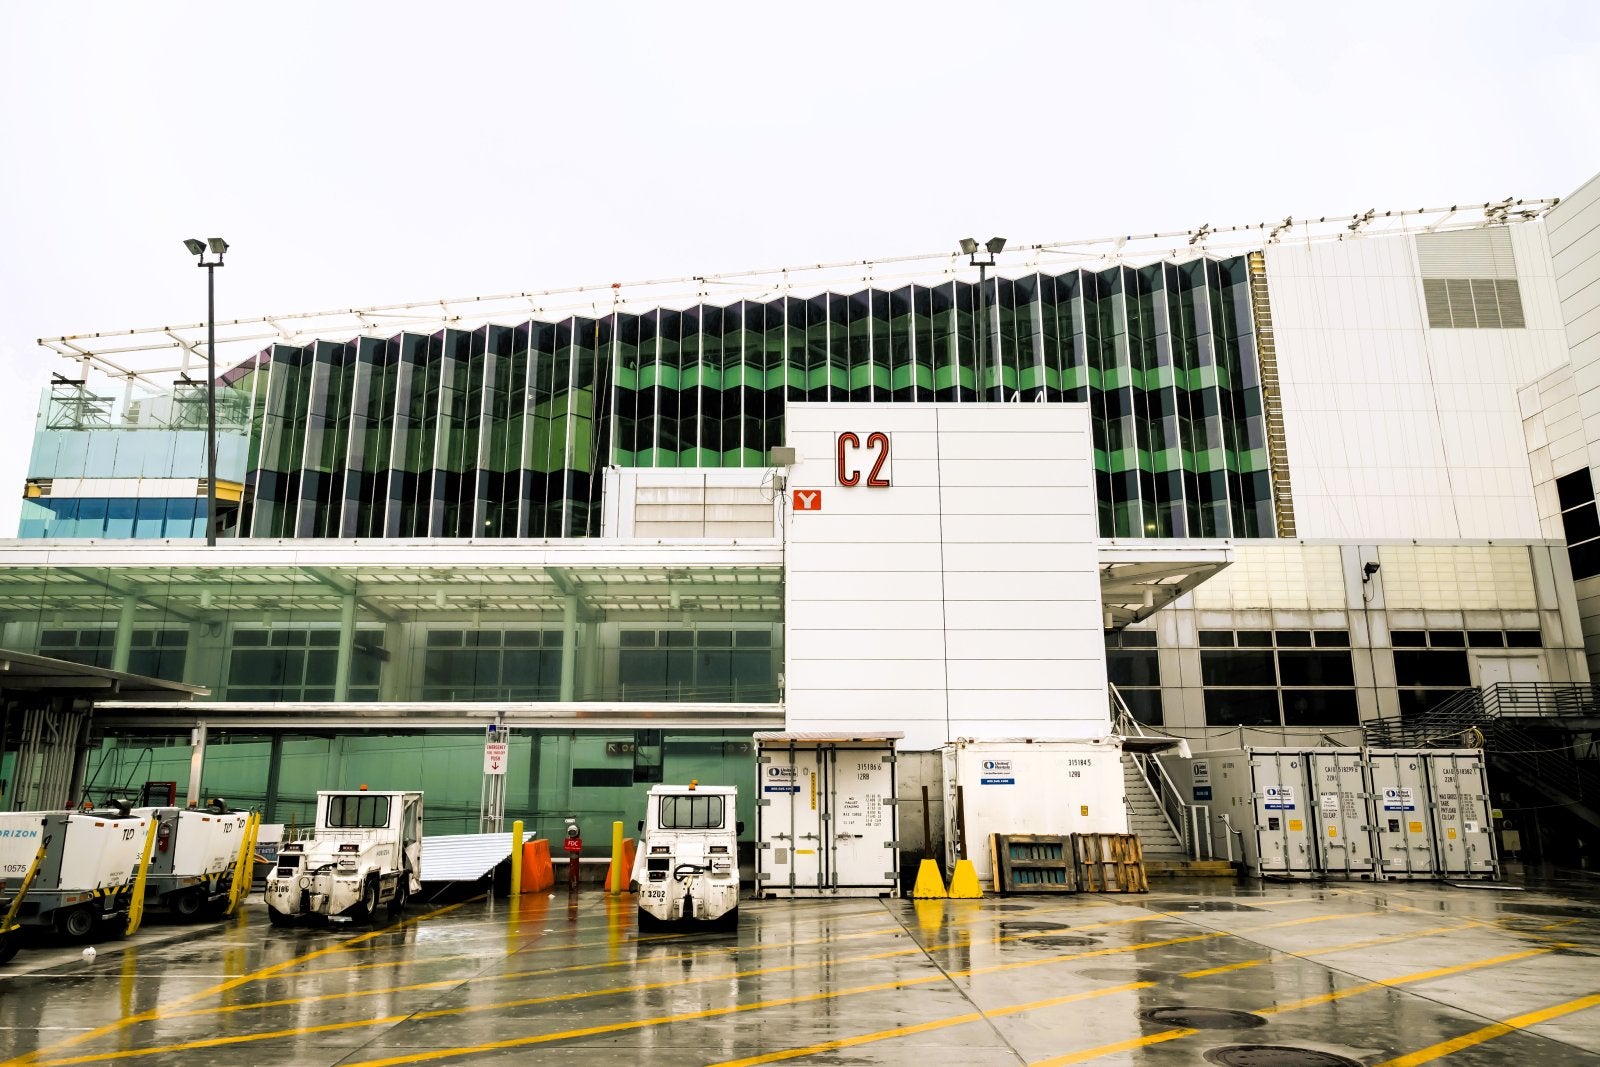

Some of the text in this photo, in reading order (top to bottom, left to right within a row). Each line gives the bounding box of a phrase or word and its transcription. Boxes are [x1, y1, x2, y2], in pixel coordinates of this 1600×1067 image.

[837, 431, 890, 488] C2
[797, 491, 818, 509] Y
[122, 828, 134, 840] TLD
